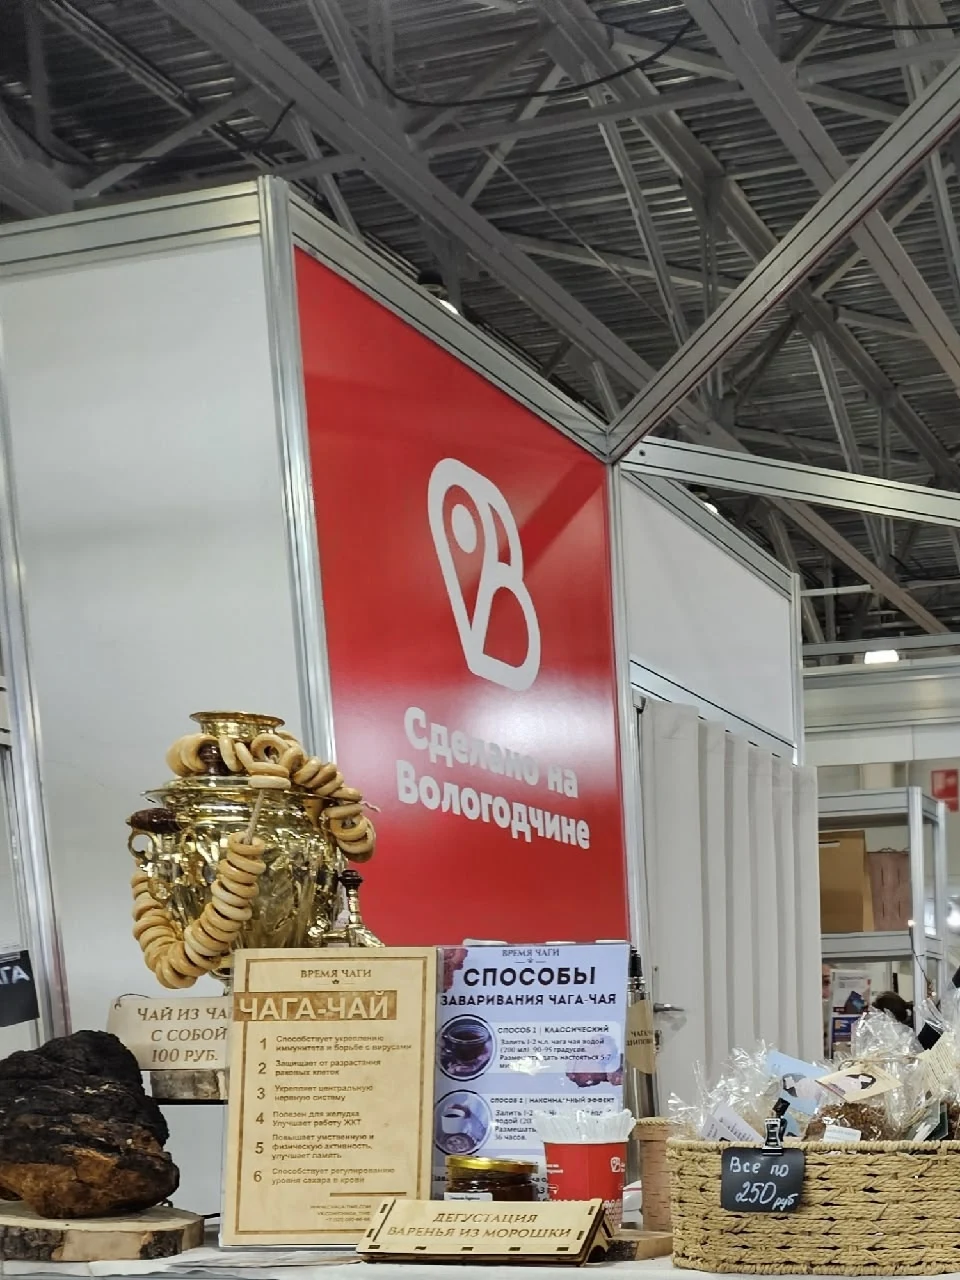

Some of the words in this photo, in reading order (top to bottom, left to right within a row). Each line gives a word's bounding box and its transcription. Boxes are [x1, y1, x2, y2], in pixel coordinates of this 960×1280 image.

[404, 706, 539, 786] Сделано
[548, 763, 578, 799] на
[396, 759, 591, 850] Вологодчине
[502, 949, 533, 957] ВРЕМЯ
[535, 948, 560, 957] ЧАГИ
[0, 965, 30, 984] ГА
[300, 969, 338, 979] ВРЕМЯ
[341, 969, 372, 978] ЧАГИ
[463, 966, 596, 987] СПОСОБЫ
[239, 990, 388, 1021] ЧАГА-ЧАЙ
[440, 994, 544, 1007] ЗАВАРИВАНИЯ
[549, 993, 617, 1006] ЧАГА-ЧАЯ
[137, 1006, 173, 1022] ЧАЙ
[177, 1008, 199, 1021] ИЗ
[206, 1007, 228, 1020] ЧА
[151, 1029, 162, 1041] С
[167, 1026, 228, 1042] СОБОЙ
[497, 1026, 531, 1034] СПОСОБ
[544, 1025, 609, 1034] КЛАССИЧЕСКИЙ
[260, 1038, 267, 1050] 1
[276, 1035, 333, 1043] Способствует
[334, 1043, 363, 1052] борьбе
[152, 1049, 180, 1062] 100
[184, 1049, 218, 1063] РУБ.
[258, 1063, 267, 1075] 2
[275, 1059, 318, 1068] Защищает
[330, 1060, 381, 1068] разрастания
[257, 1087, 265, 1100] 3
[275, 1084, 317, 1093] Укрепляет
[312, 1094, 346, 1102] систему
[255, 1112, 264, 1125] 4
[308, 1111, 324, 1119] для
[325, 1110, 360, 1118] желудка
[272, 1119, 312, 1128] Улучшает
[313, 1119, 342, 1128] работу
[254, 1142, 264, 1155] 5
[272, 1167, 329, 1175] Способствует
[729, 1156, 761, 1174] Все
[770, 1164, 789, 1177] по
[253, 1170, 262, 1183] 6
[735, 1181, 777, 1204] 250
[771, 1193, 799, 1211] руб
[432, 1212, 538, 1224] ДЕГУСТАЦИЯ
[387, 1226, 457, 1238] ВАРЕНЬЯ
[458, 1227, 480, 1238] ИЗ
[482, 1228, 571, 1240] МОРОШКИ
